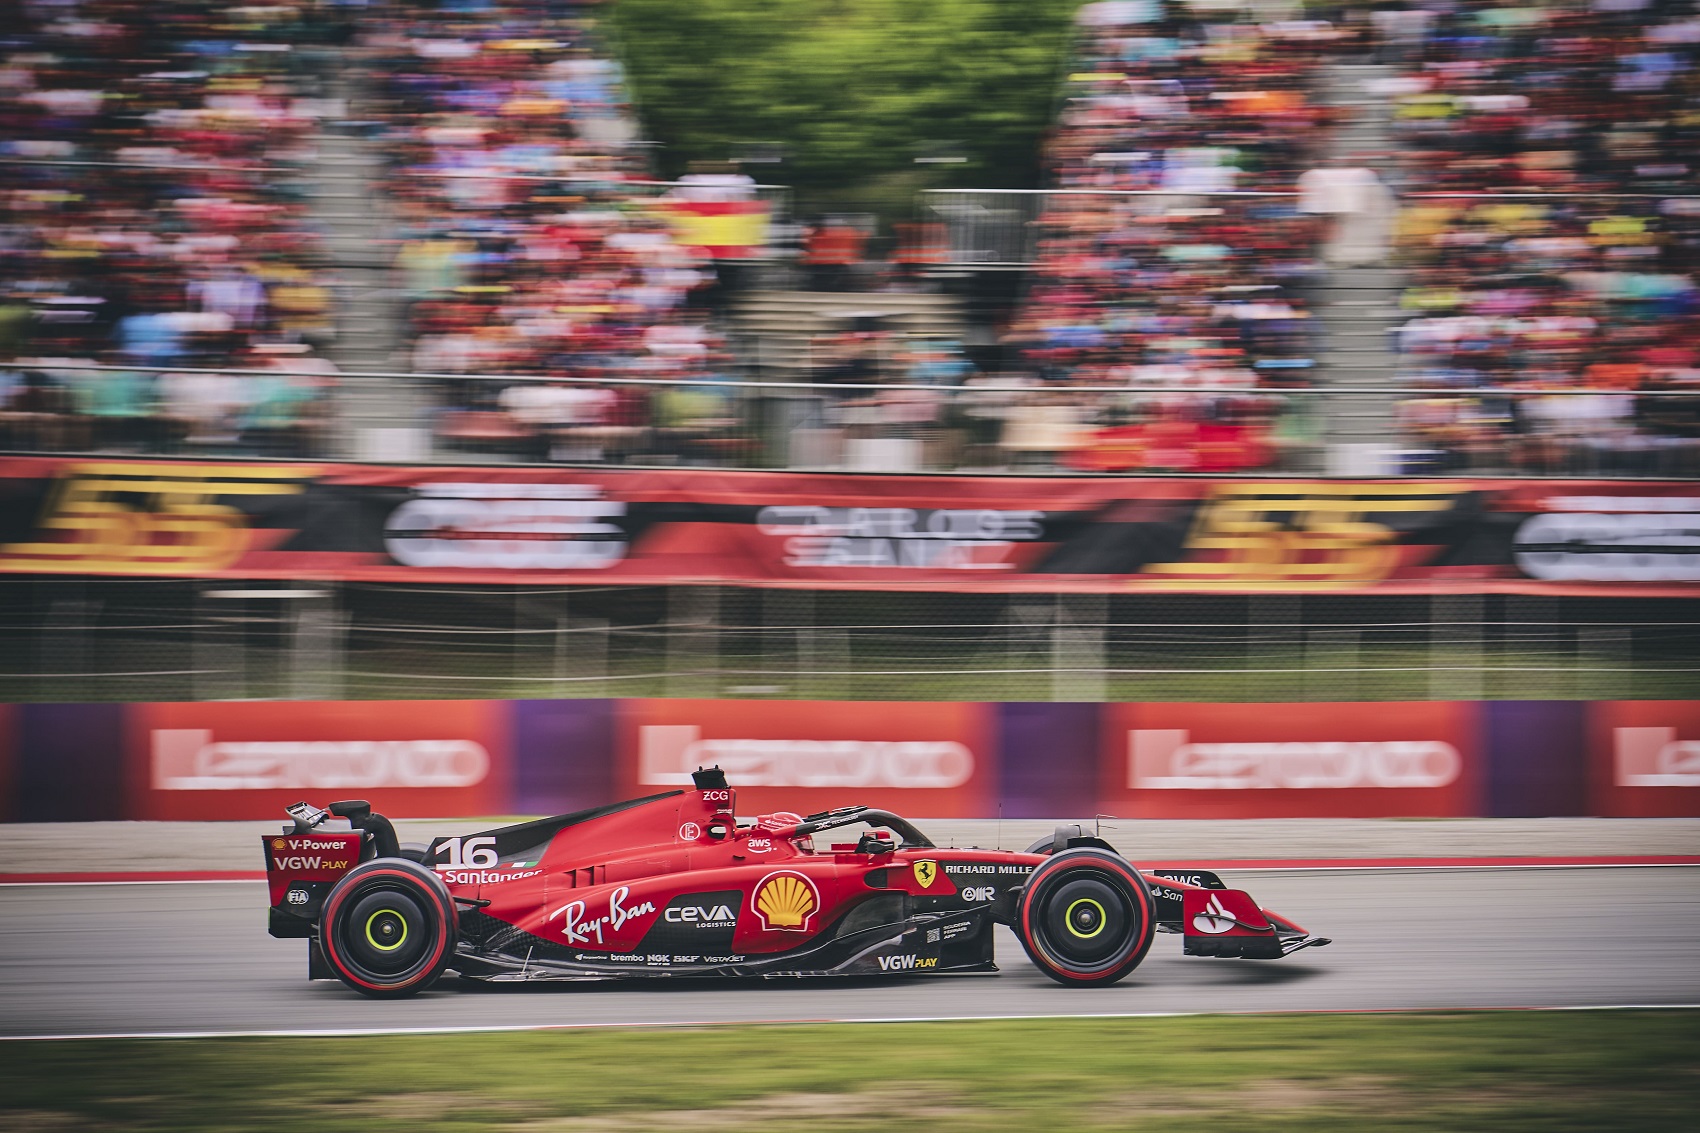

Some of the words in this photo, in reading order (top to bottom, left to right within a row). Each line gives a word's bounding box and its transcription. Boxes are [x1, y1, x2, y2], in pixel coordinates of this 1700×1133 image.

[703, 790, 728, 800] ZCG
[288, 839, 346, 850] V-Power
[747, 838, 771, 848] aws
[435, 836, 499, 870] 16
[274, 856, 321, 871] VGW
[322, 861, 347, 869] PLAY
[945, 865, 995, 874] RICHARD
[998, 866, 1033, 874] MILLE
[445, 869, 543, 884] Santander
[549, 886, 656, 944] Ray-Ban
[610, 953, 645, 962] brembo
[647, 954, 670, 962] NGK
[672, 955, 700, 963] SKF
[877, 954, 916, 971] VGW
[915, 957, 938, 968] PLAY
